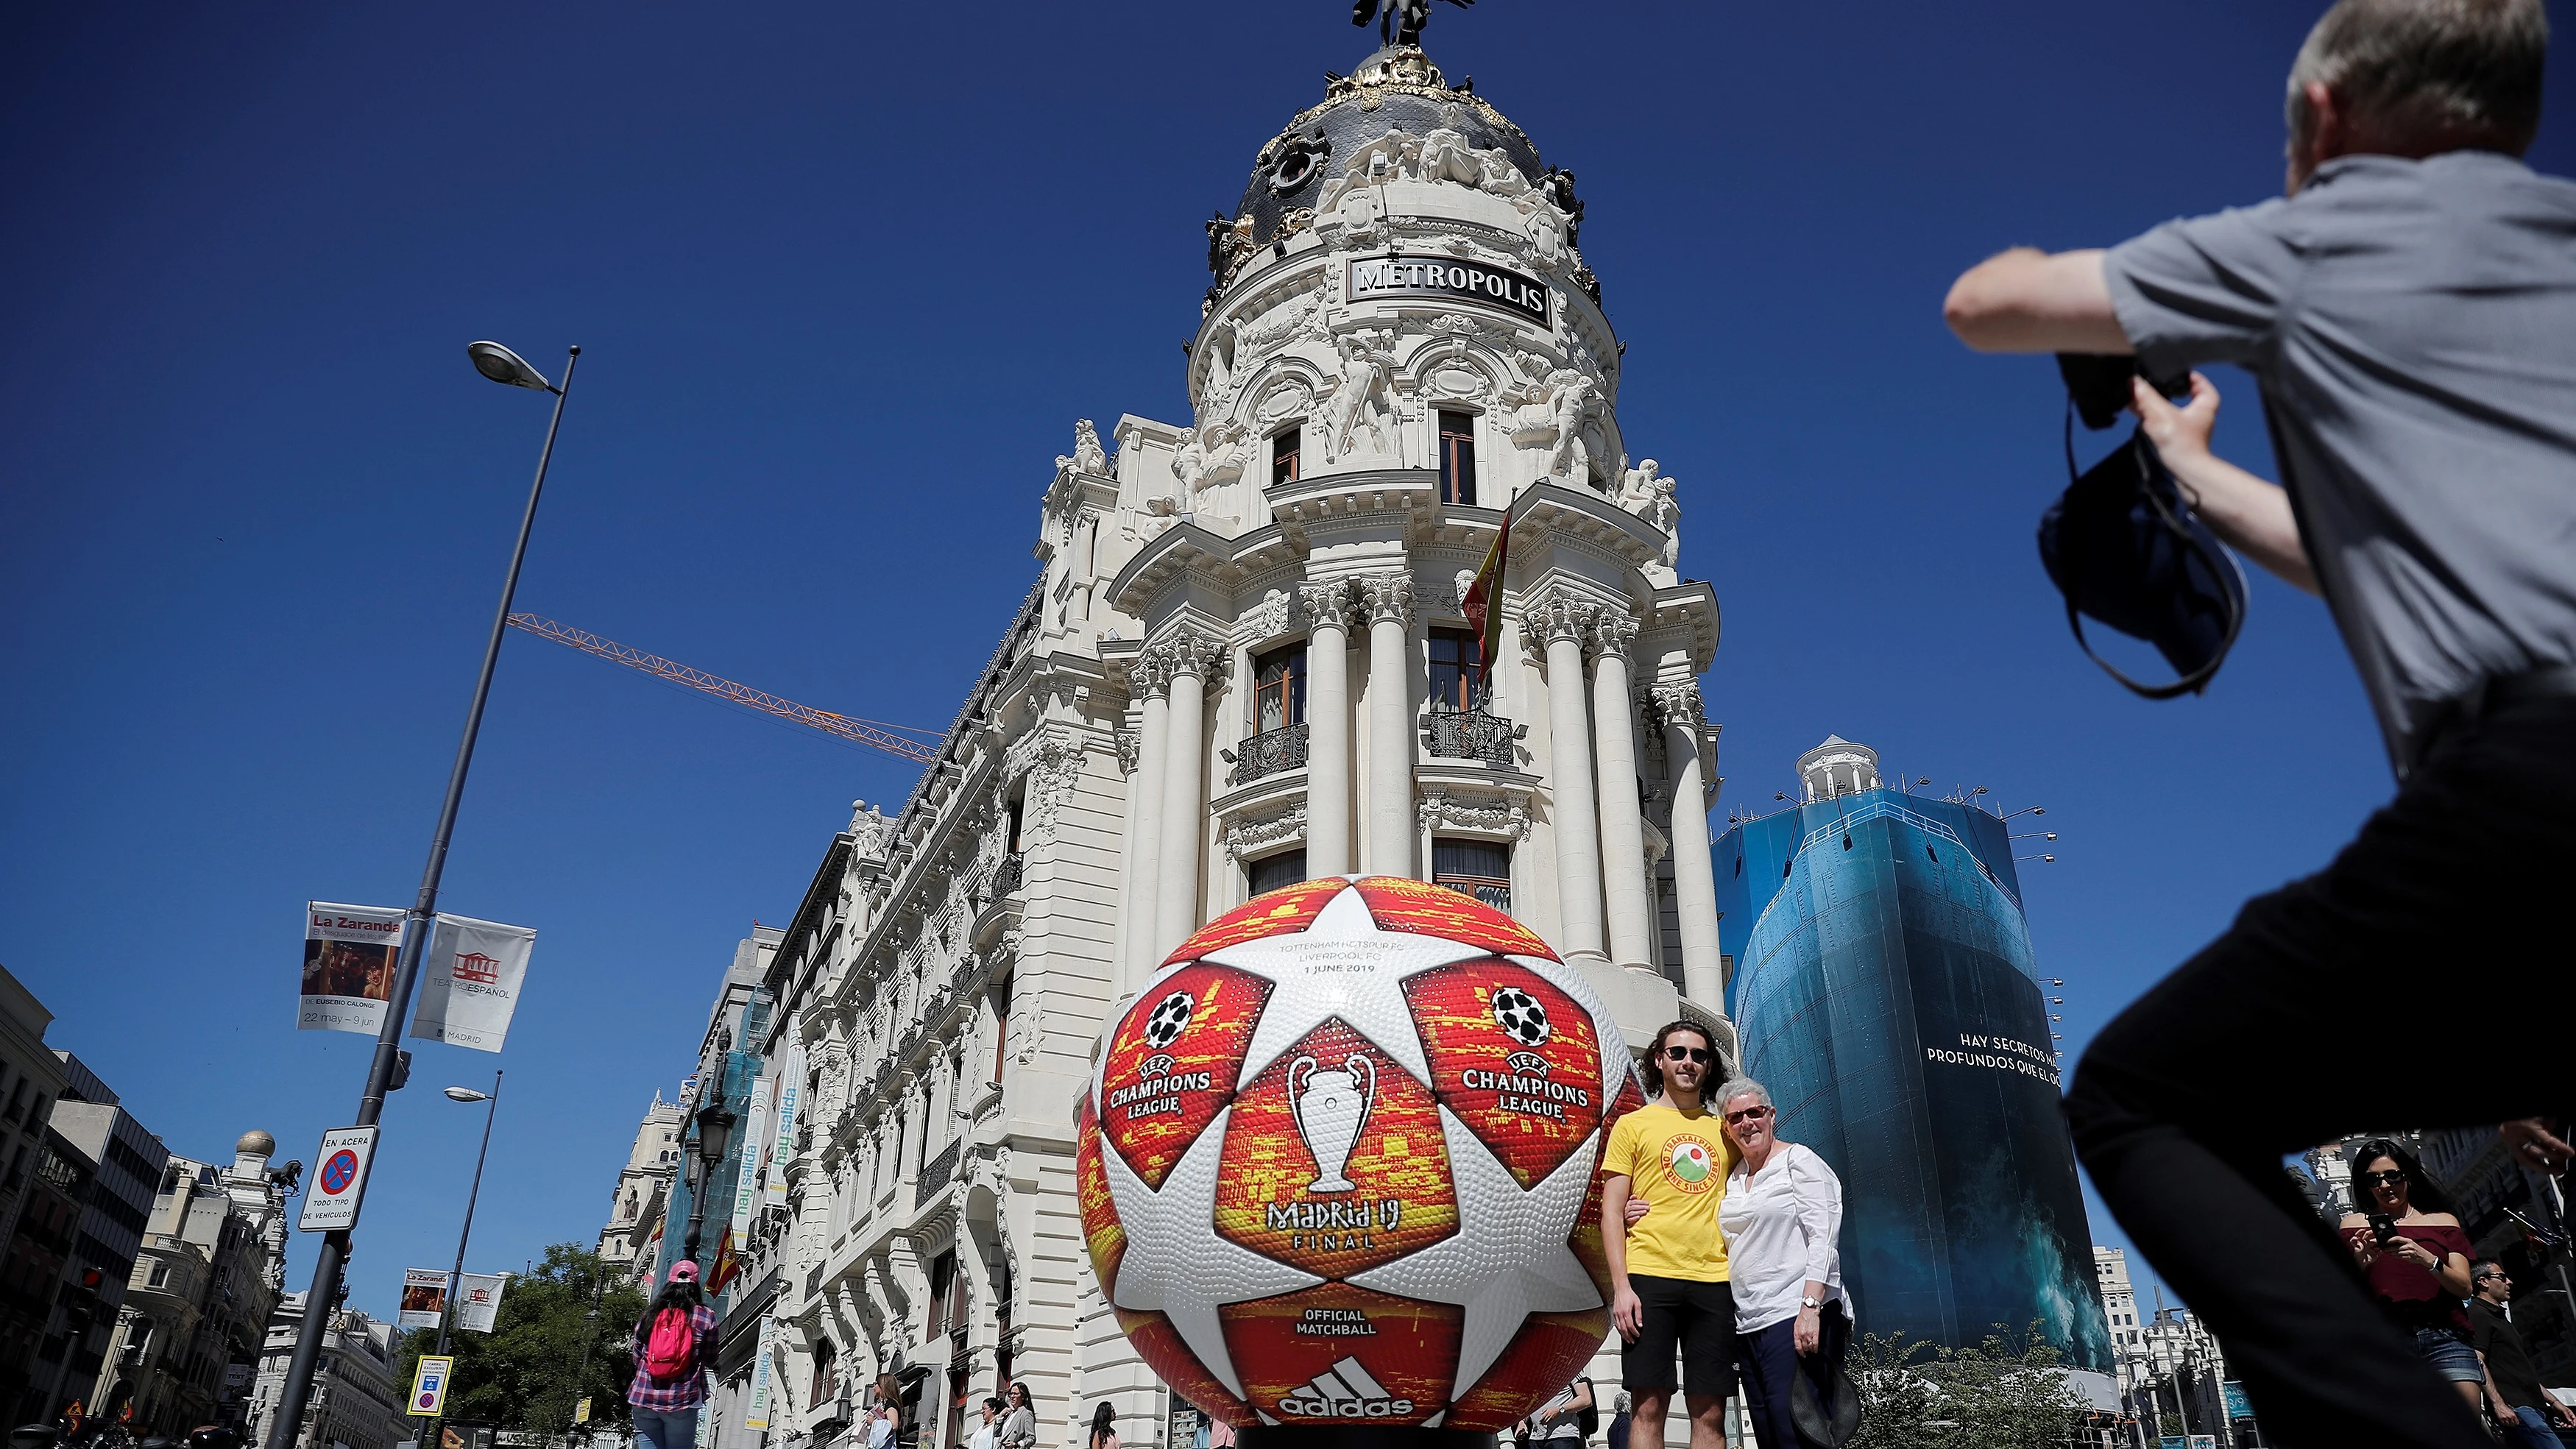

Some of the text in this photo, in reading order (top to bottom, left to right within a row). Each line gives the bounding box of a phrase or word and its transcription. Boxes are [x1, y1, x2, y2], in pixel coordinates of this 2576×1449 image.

[1359, 264, 1543, 312] METROPOLIS
[314, 915, 401, 932] La Zaranda
[1280, 940, 1404, 953] TOTTENHAM HOTSPUR FC
[1299, 952, 1382, 962] LIVERPOOL FC
[1313, 964, 1343, 974] JUNE
[1346, 964, 1376, 973] 2019
[347, 1000, 376, 1009] CALONGE
[304, 1013, 318, 1022] 22
[321, 1014, 344, 1024] may
[353, 1016, 360, 1025] 9
[361, 1016, 375, 1027] jun
[447, 1031, 481, 1044] MADRID
[1960, 1032, 1988, 1048] HAY
[1993, 1036, 2045, 1063] SECRETOS
[1141, 1057, 1172, 1077] UEFA
[1509, 1055, 1549, 1076] UEFA
[1927, 1047, 2015, 1070] PROFUNDOS
[2017, 1060, 2038, 1078] QUE
[2038, 1068, 2050, 1083] EL
[1110, 1071, 1211, 1108] CHAMPIONS
[1462, 1069, 1588, 1107] CHAMPIONS
[779, 1088, 797, 1134] salida
[325, 1137, 369, 1147] EN ACERA
[773, 1136, 794, 1166] hay
[1664, 1135, 1716, 1158] TRANSALPINO
[741, 1145, 757, 1186] salida
[1663, 1156, 1719, 1191] NO ONE SINCE 1988
[735, 1188, 754, 1216] hay
[315, 1211, 352, 1219] VEHÍCULOS
[1379, 1200, 1400, 1230] 19
[1293, 1234, 1373, 1250] FINAL
[417, 1275, 447, 1283] Zaranda
[1305, 1309, 1365, 1321] OFFICIAL
[1297, 1323, 1376, 1335] MATCHBALL
[758, 1352, 771, 1387] salida
[752, 1387, 768, 1410] hay
[1279, 1397, 1413, 1417] adidas
